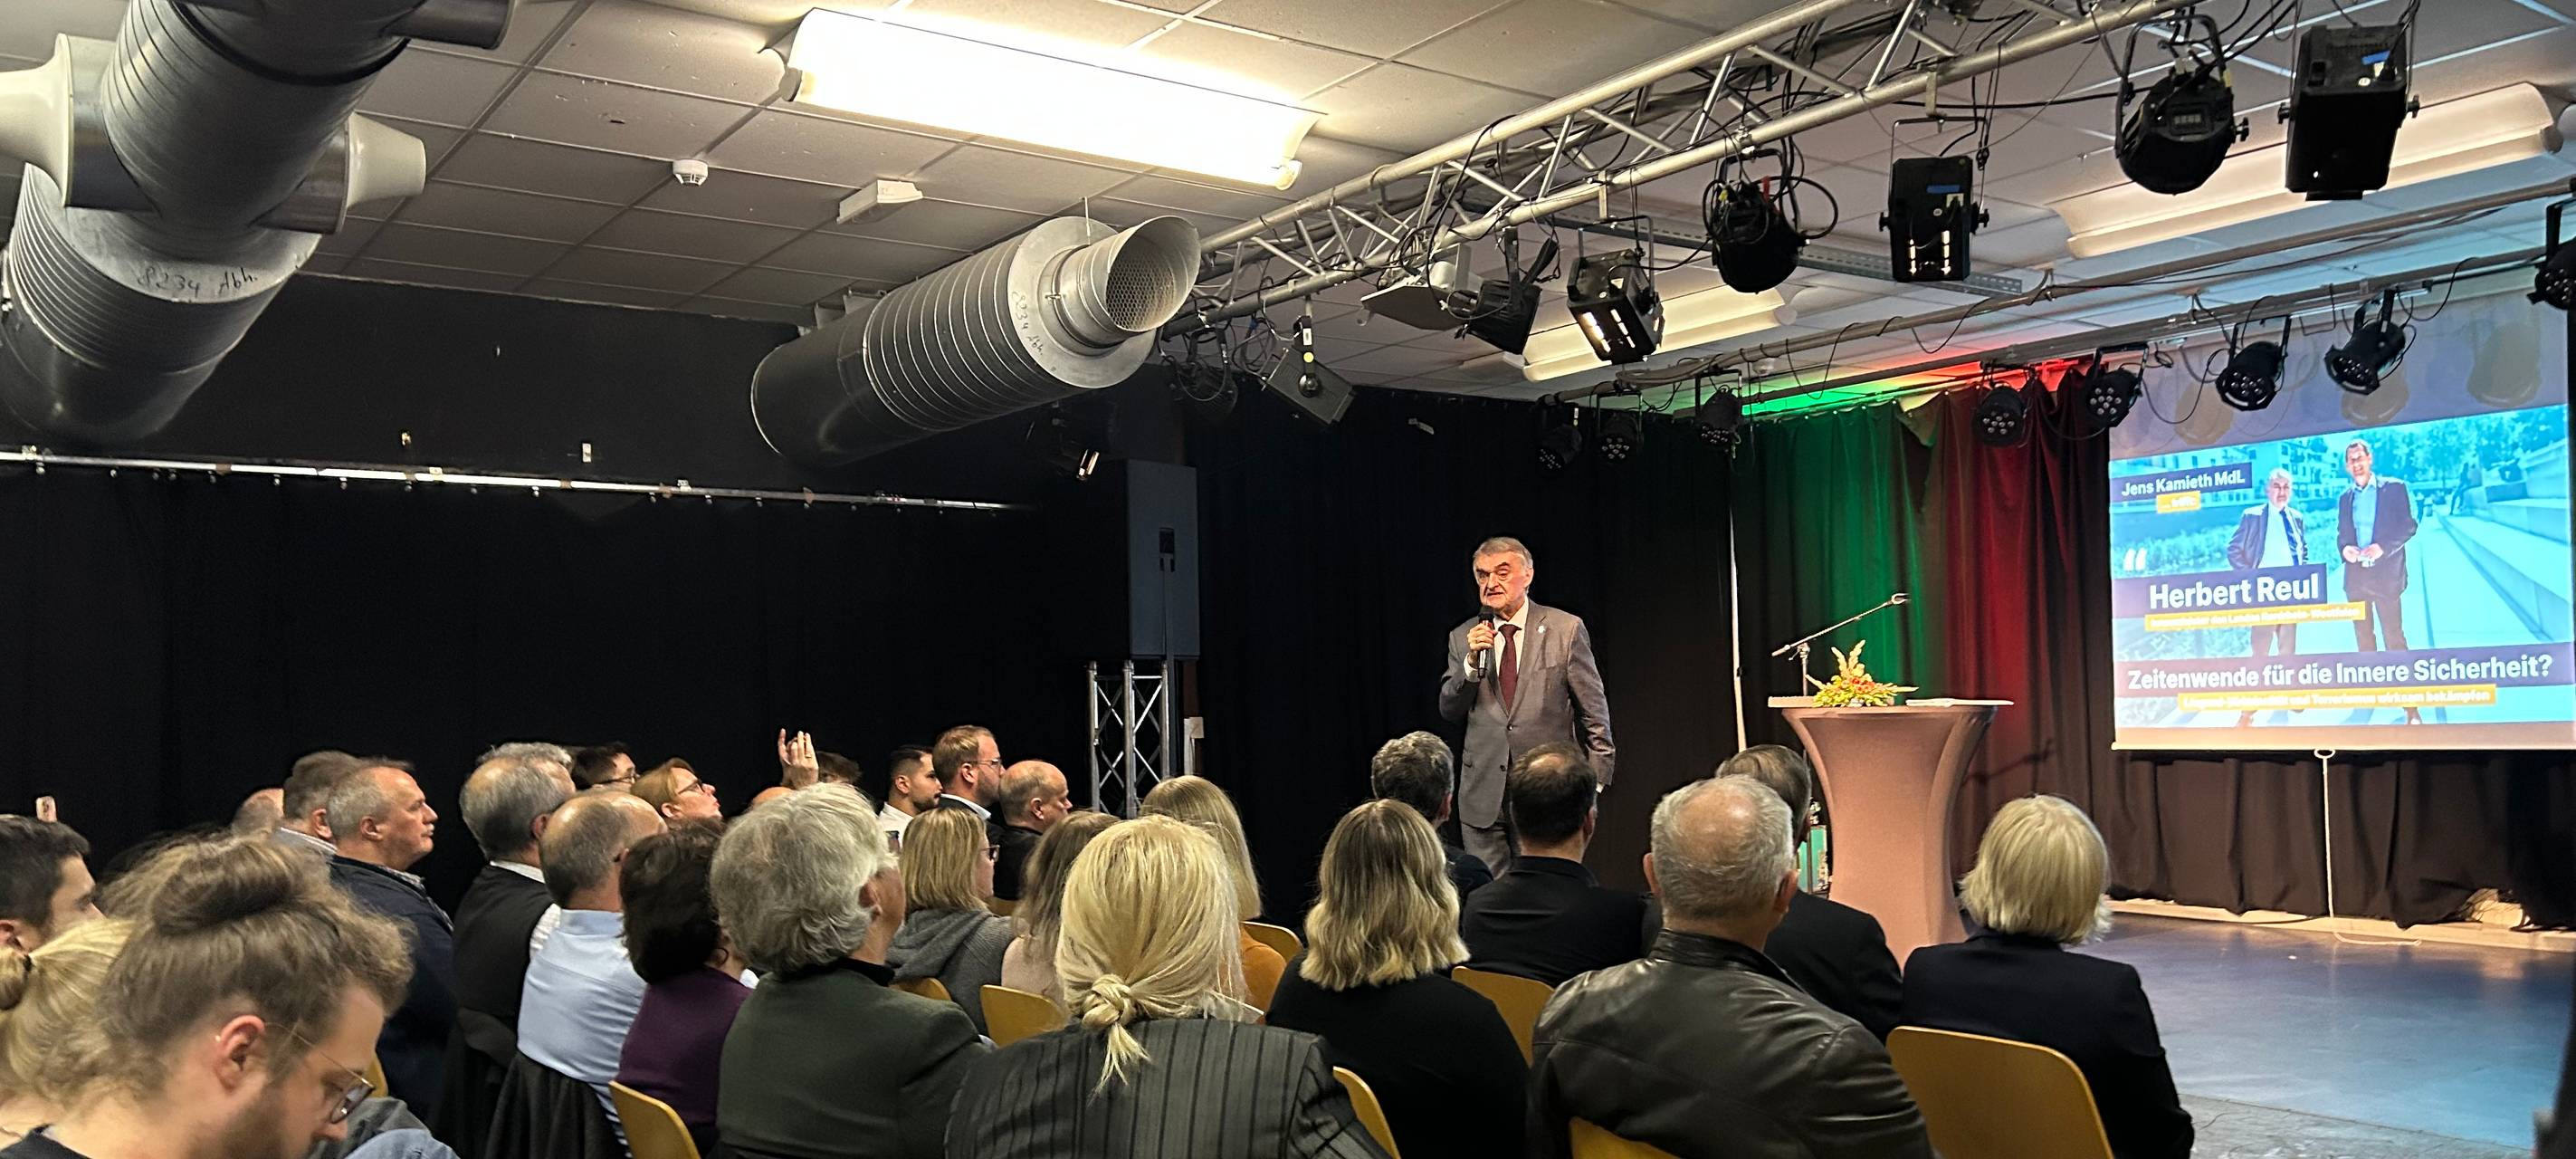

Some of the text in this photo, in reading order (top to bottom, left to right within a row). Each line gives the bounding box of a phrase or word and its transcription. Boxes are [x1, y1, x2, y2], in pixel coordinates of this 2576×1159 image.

[2121, 469, 2246, 497] Jens Kamieth MdL
[2149, 573, 2319, 609] Herbert Reul
[2127, 654, 2553, 690] Zeitenwende für die Innere Sicherheit?
